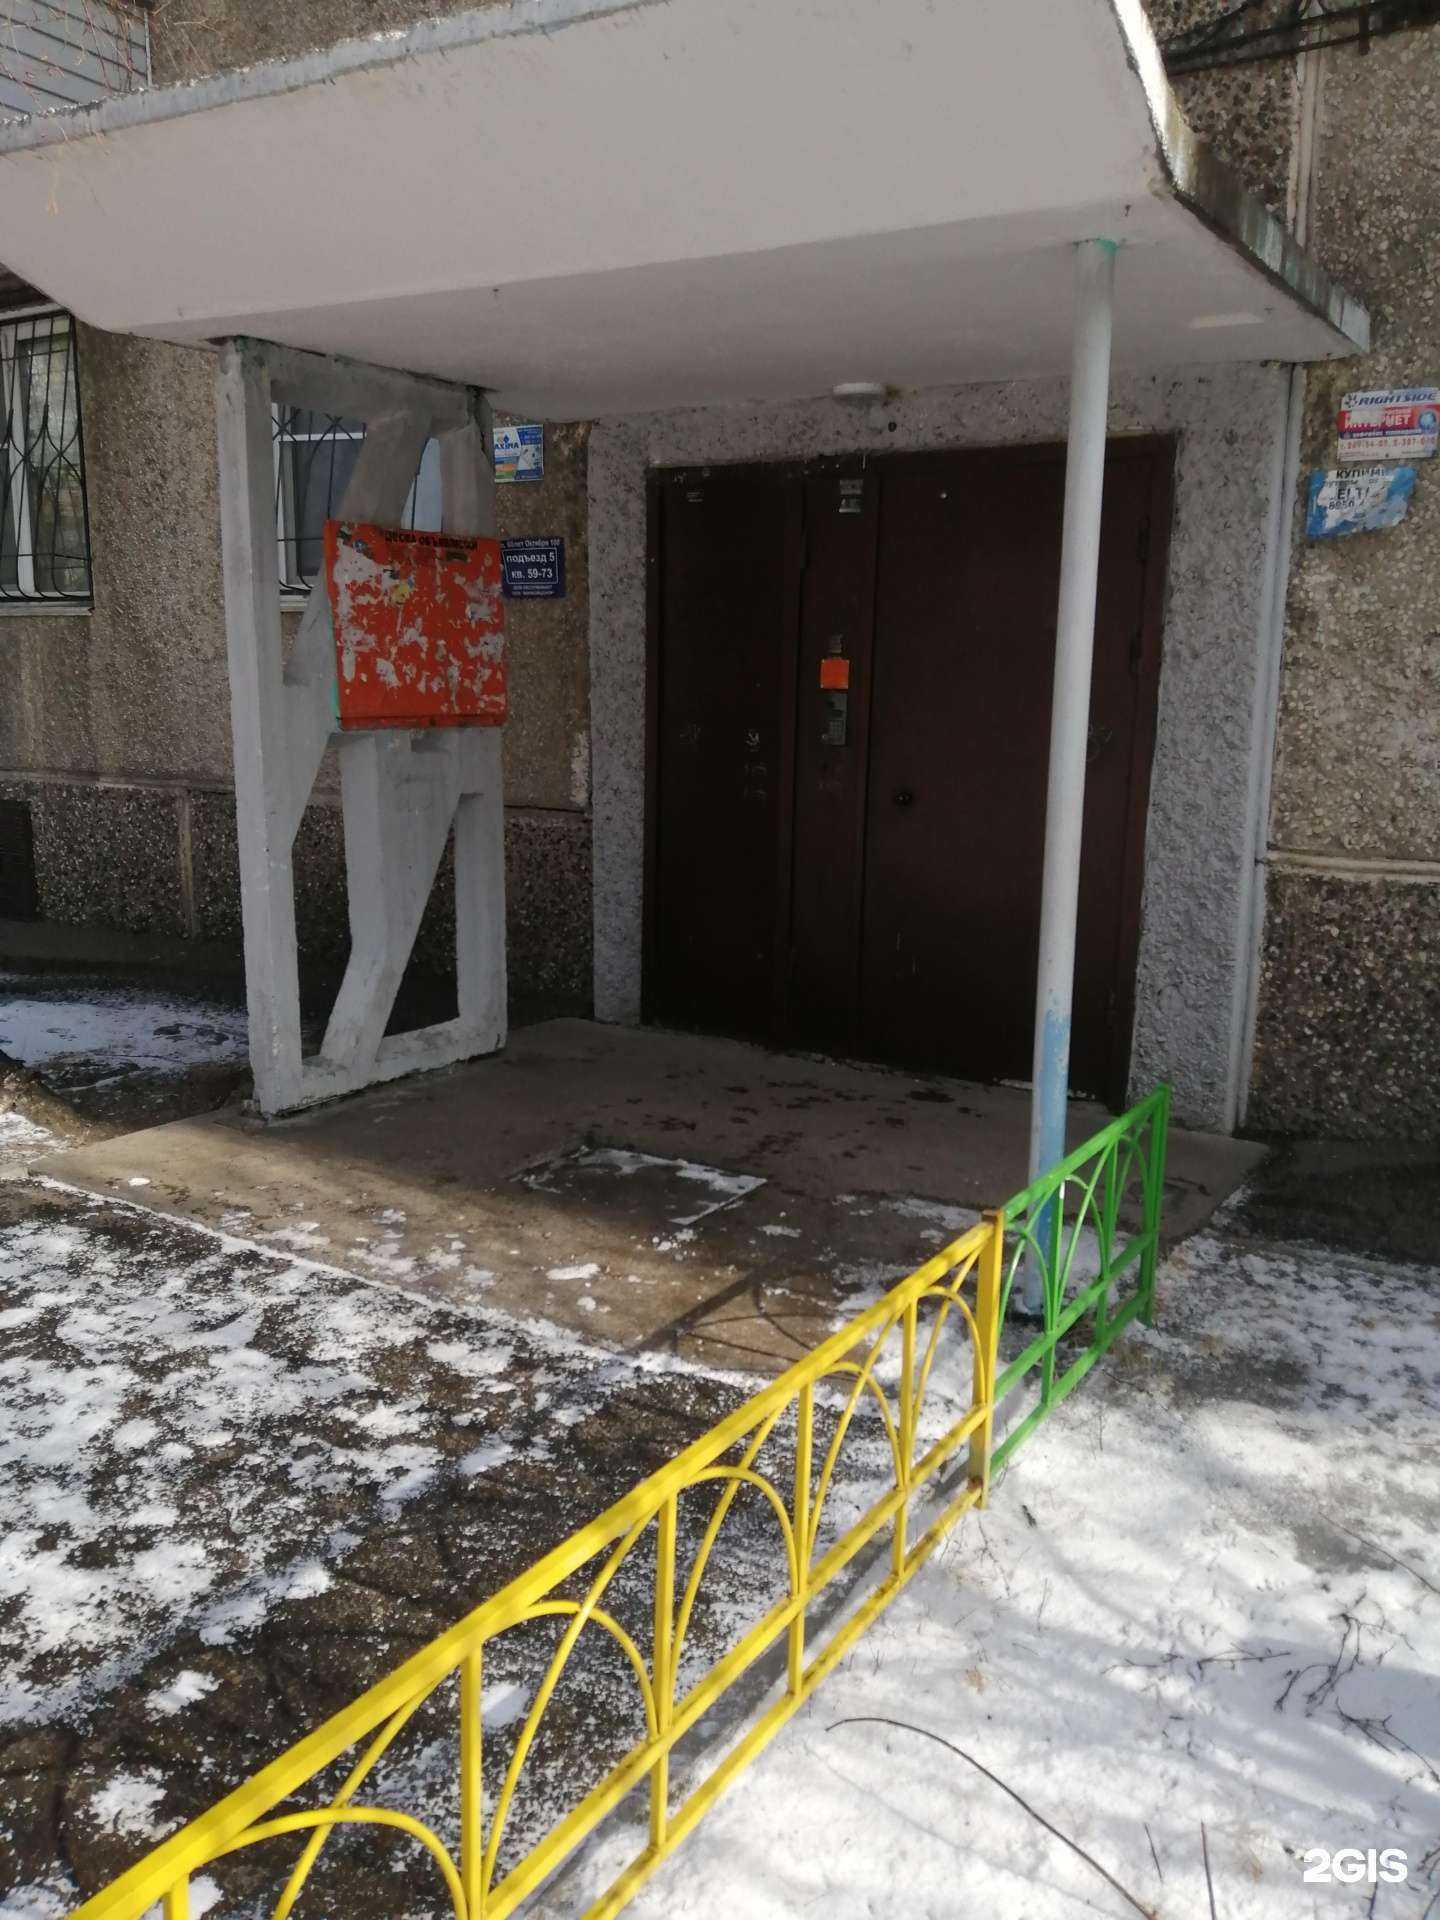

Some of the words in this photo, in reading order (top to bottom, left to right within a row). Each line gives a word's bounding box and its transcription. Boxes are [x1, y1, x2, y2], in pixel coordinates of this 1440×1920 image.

[506, 554, 547, 563] подъезд
[549, 551, 555, 562] 5
[511, 570, 526, 579] кв.
[527, 568, 553, 579] 59-73
